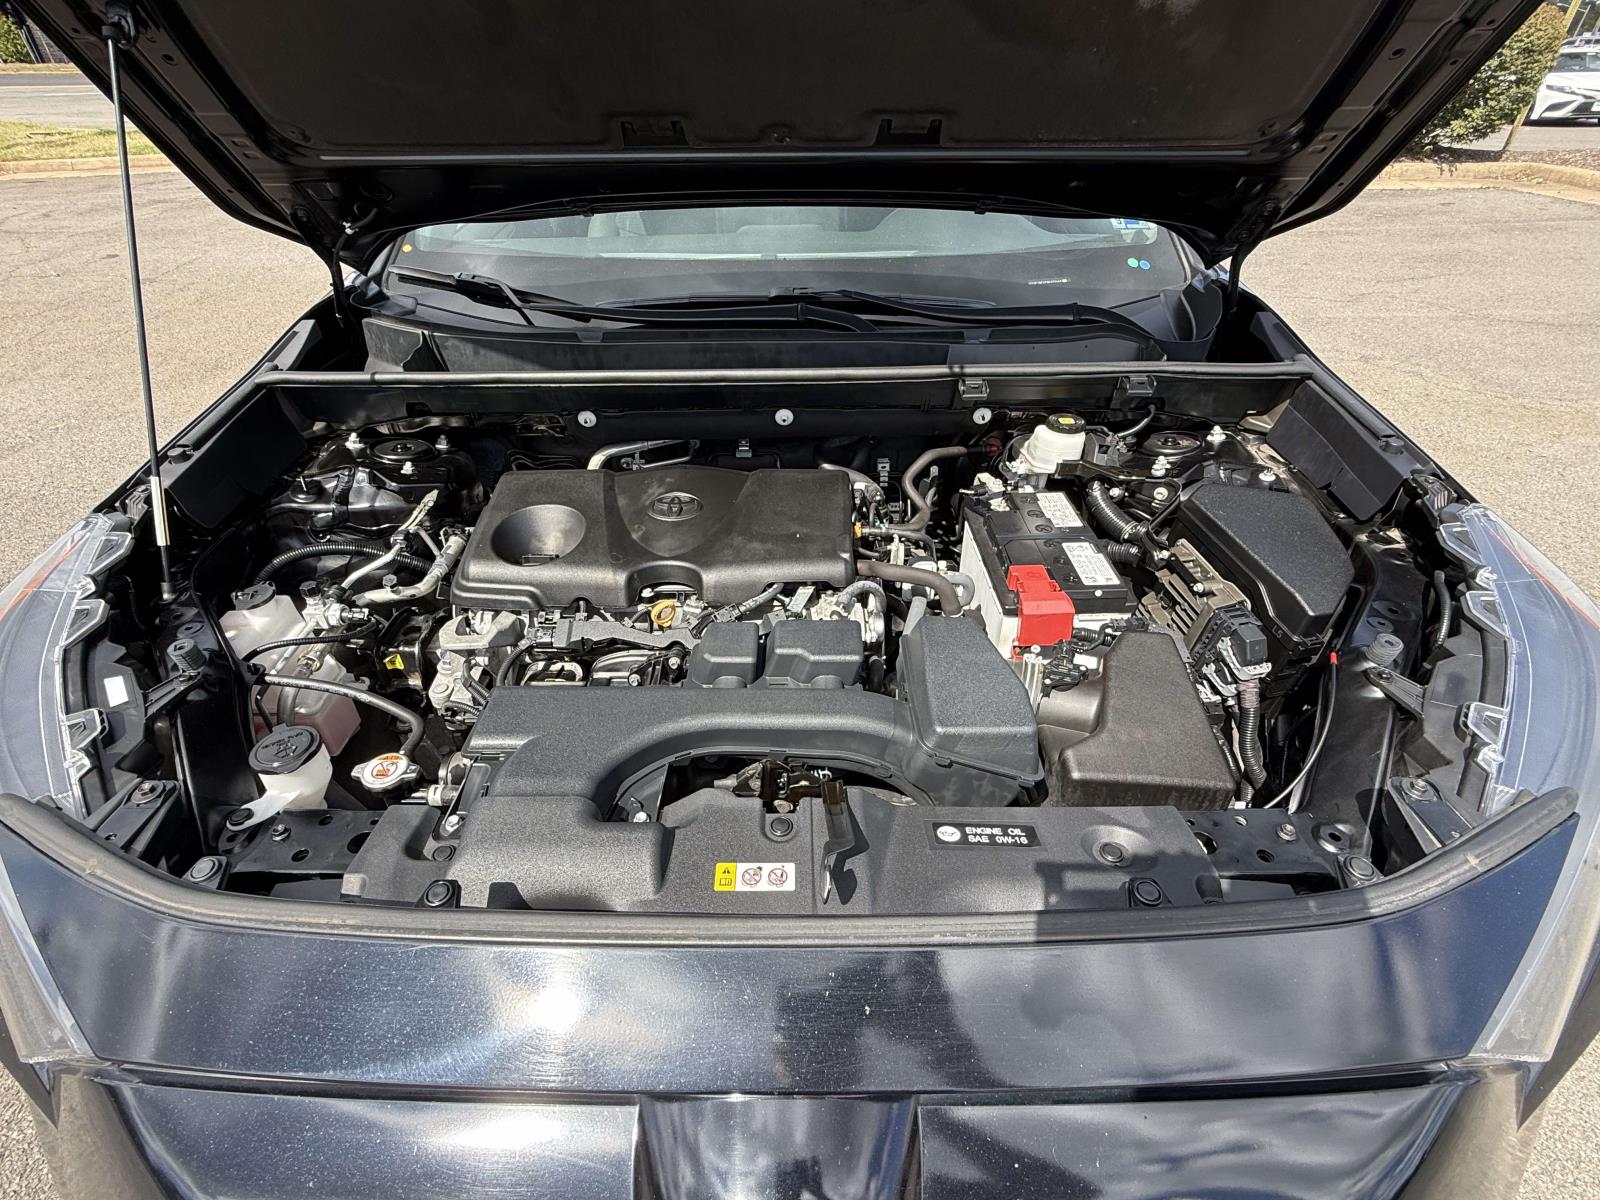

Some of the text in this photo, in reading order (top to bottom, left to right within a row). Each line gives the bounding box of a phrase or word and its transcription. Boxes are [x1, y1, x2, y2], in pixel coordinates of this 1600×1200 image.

[965, 826, 1026, 836] ENGINE OIL
[967, 835, 1028, 844] SAE 0W-16
